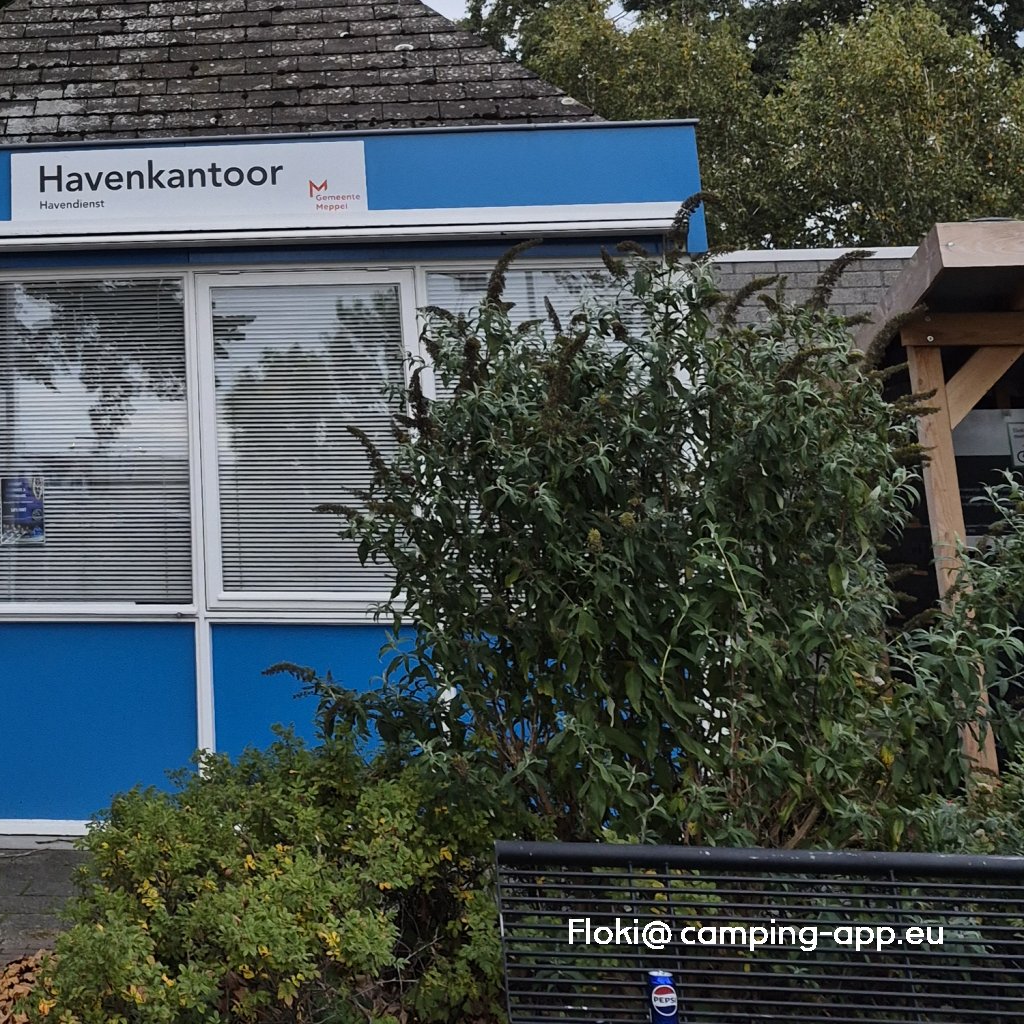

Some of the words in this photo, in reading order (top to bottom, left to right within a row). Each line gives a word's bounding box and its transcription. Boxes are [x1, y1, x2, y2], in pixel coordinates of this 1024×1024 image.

[39, 159, 284, 193] Havenkantoor
[39, 199, 105, 210] Havendienst
[316, 203, 348, 211] Meppel
